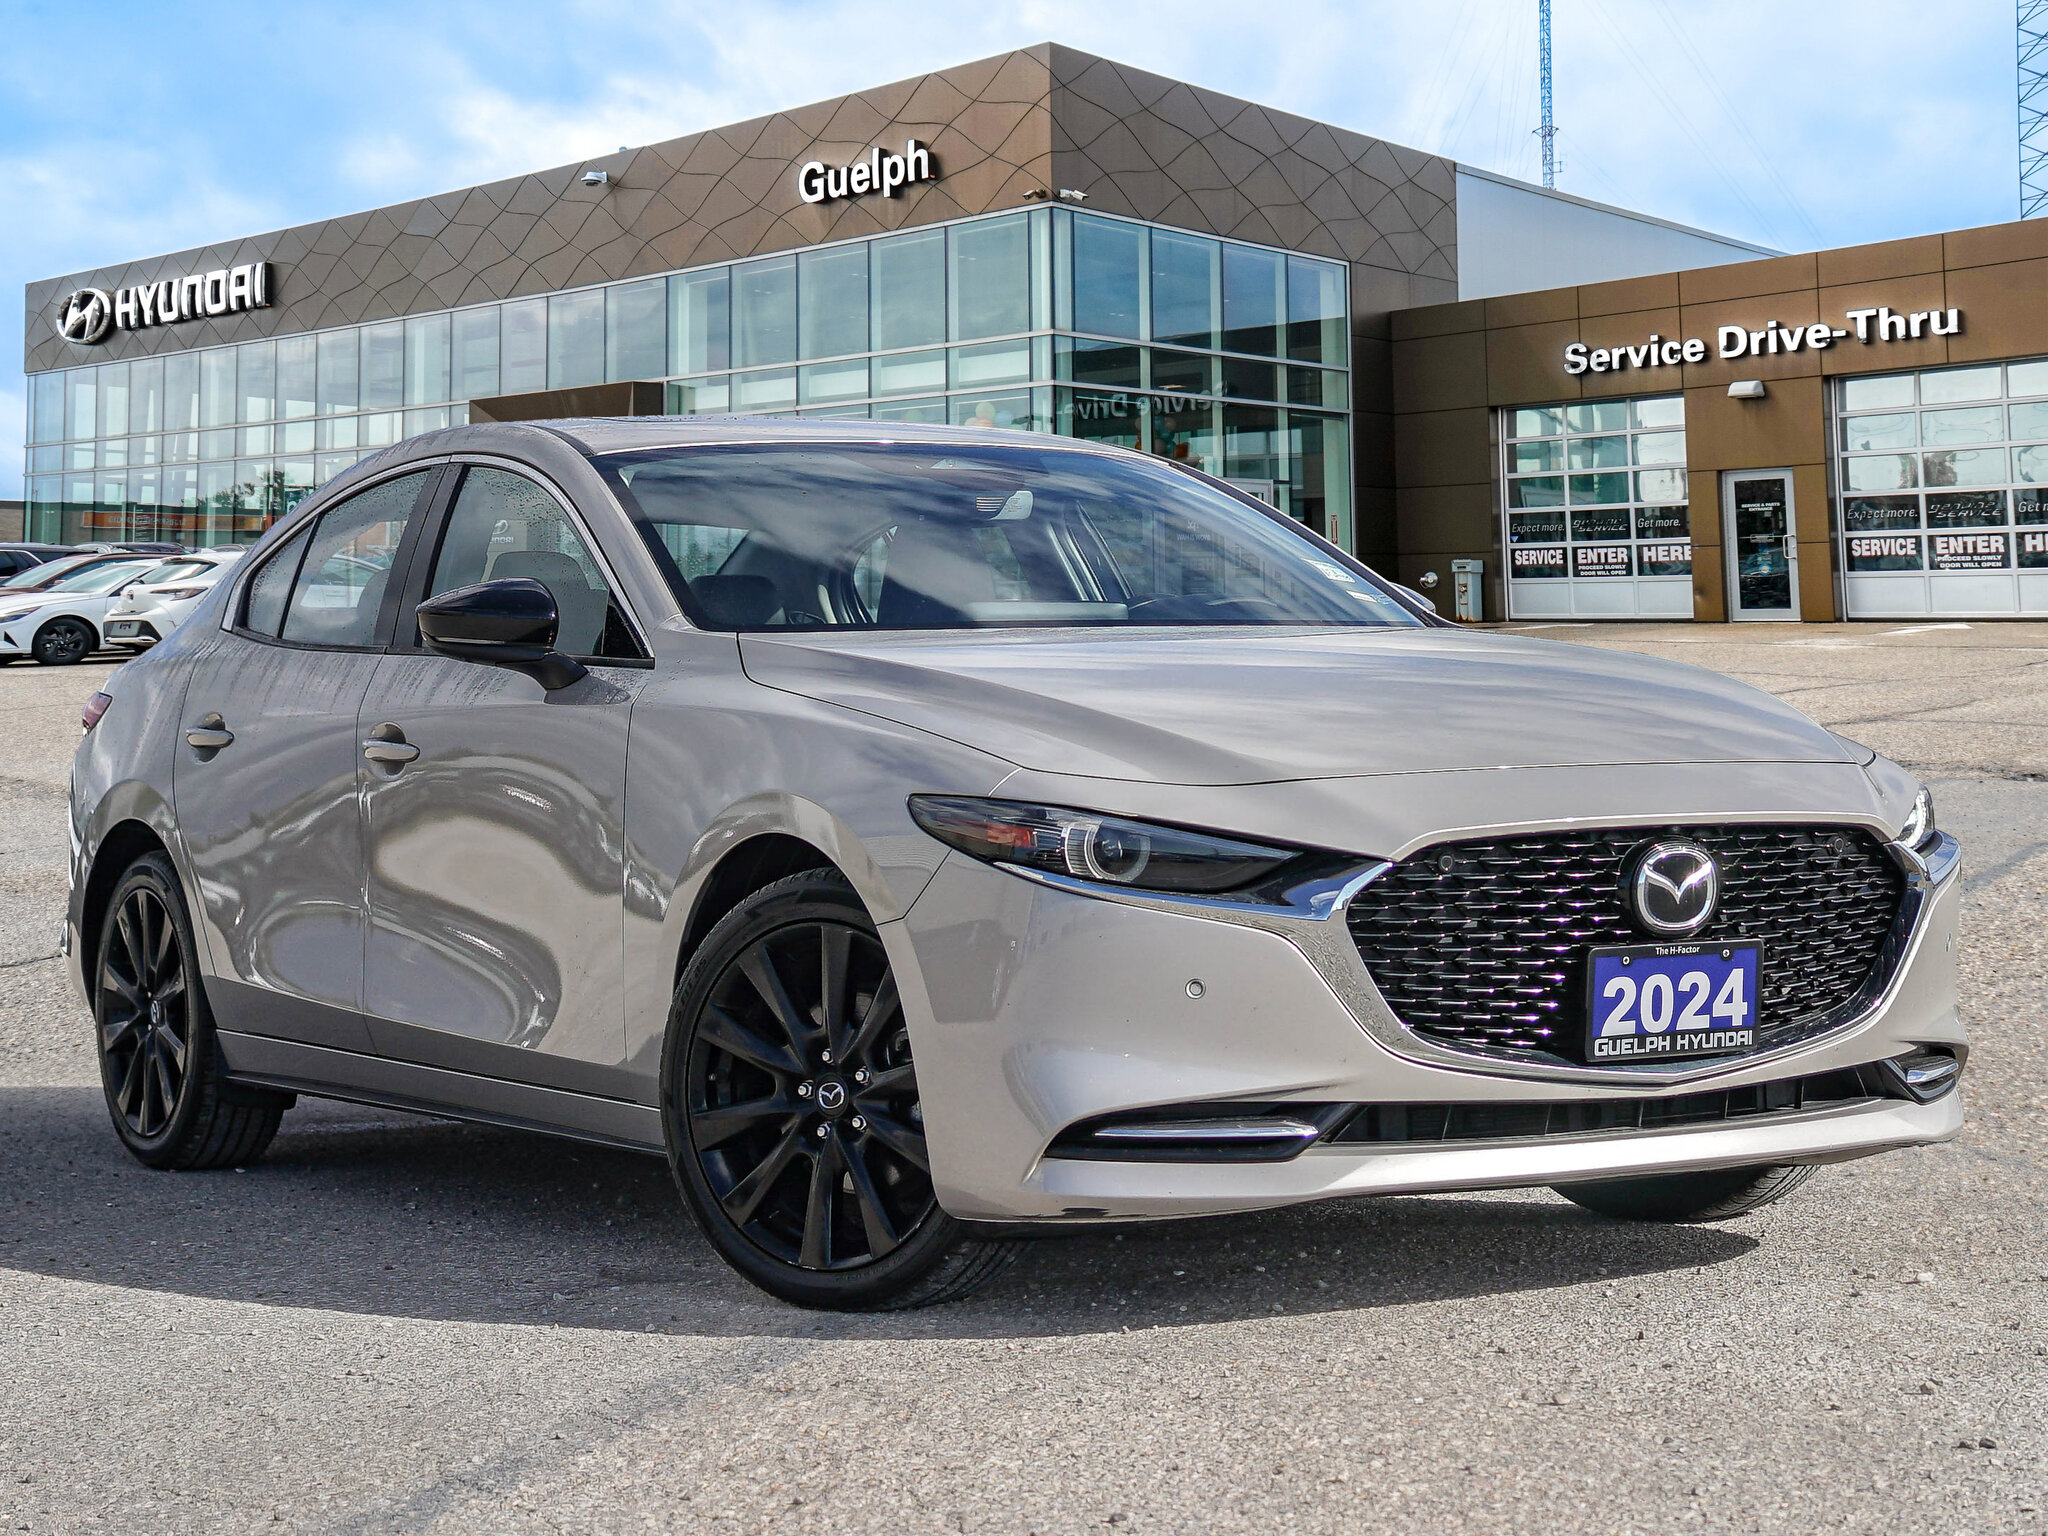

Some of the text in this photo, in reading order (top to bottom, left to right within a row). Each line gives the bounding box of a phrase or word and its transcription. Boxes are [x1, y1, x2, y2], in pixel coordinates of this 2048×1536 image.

[798, 138, 930, 203] Guelph
[115, 262, 269, 330] HYUNDAI
[1563, 306, 1962, 375] Service Drive-Thru
[1847, 507, 1918, 520] Expect more.
[1936, 508, 2004, 518] SERVICE
[2018, 501, 2040, 513] Get
[1512, 523, 1565, 534] Expect more.
[1637, 517, 1681, 528] Get more.
[1851, 537, 1917, 557] SERVICE
[1935, 535, 2005, 554] ENTER
[1515, 549, 1564, 566] SERVICE
[1577, 547, 1629, 564] ENTER
[1642, 545, 1692, 562] HERE
[1655, 945, 1700, 956] The H-Factor
[1601, 967, 1748, 1037] 2024
[1594, 1029, 1753, 1057] GUELPH HYUNDAI
